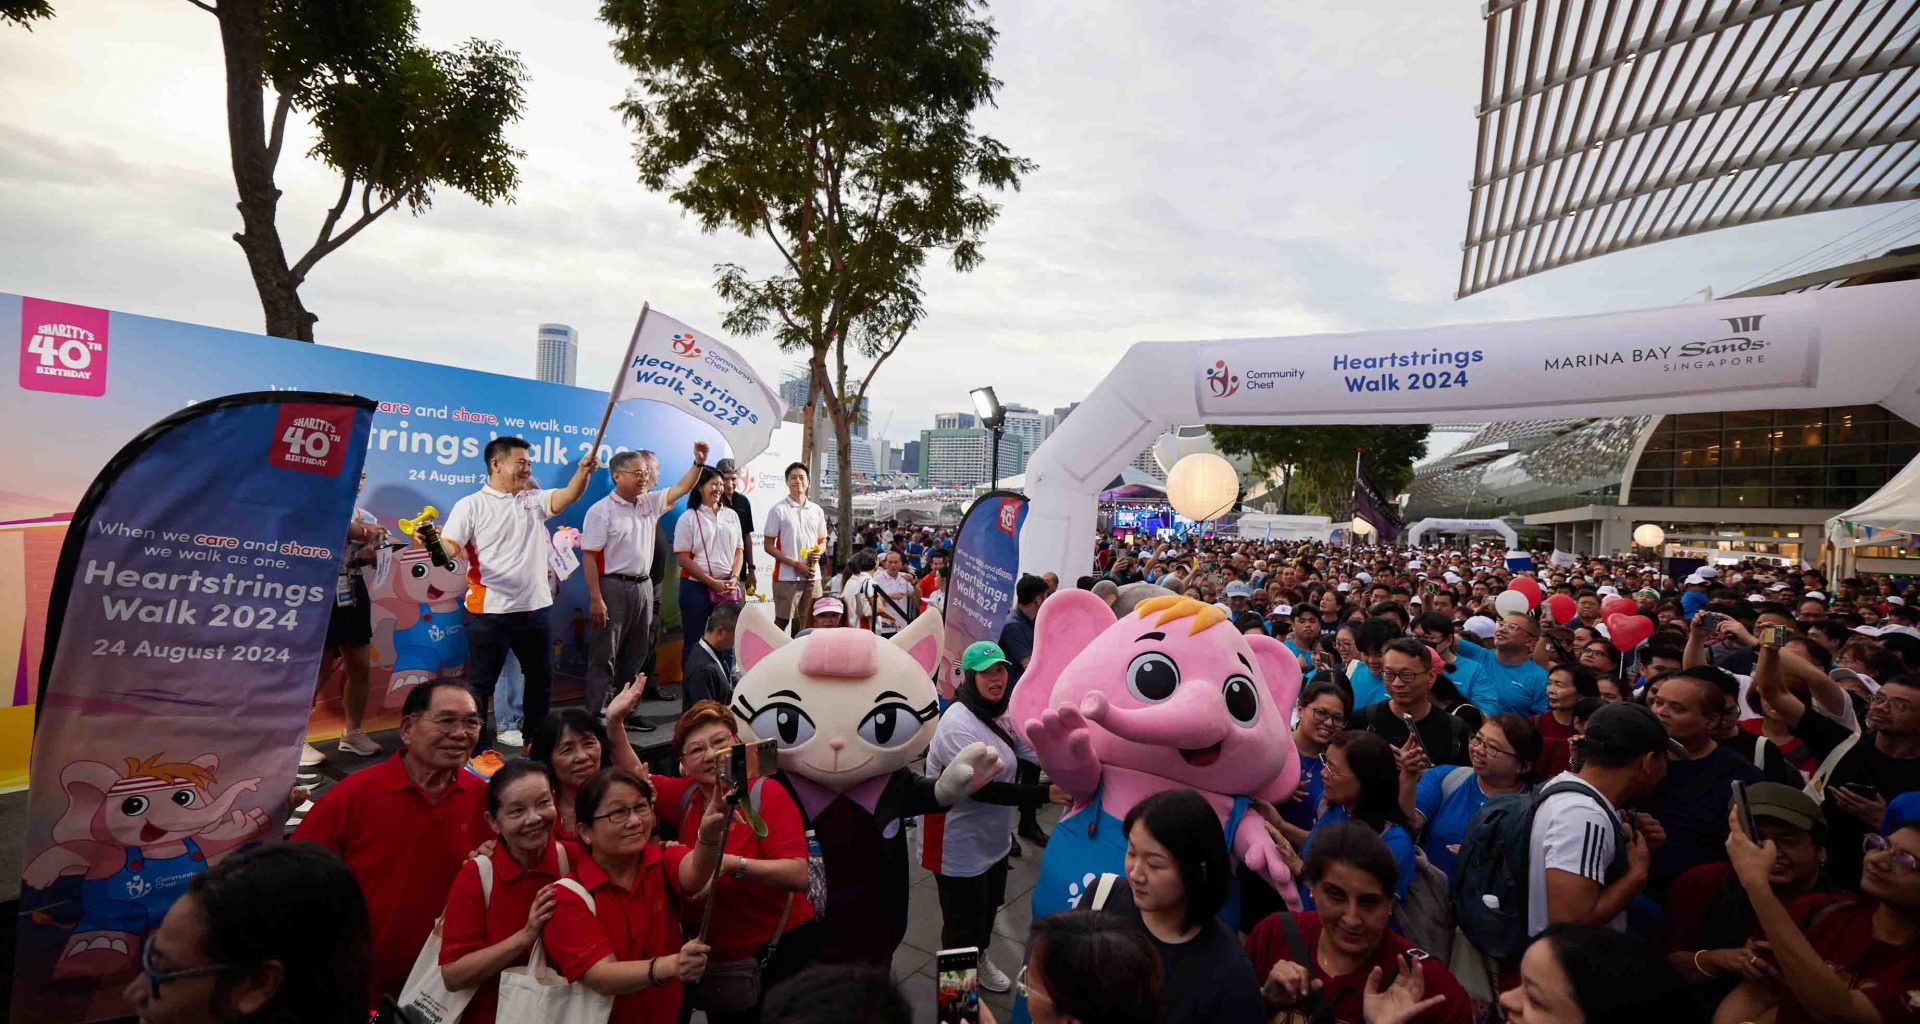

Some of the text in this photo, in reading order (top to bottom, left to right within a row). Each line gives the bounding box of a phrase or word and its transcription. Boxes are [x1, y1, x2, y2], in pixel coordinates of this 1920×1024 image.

[704, 356, 730, 374] Chest
[1333, 348, 1484, 371] Heartstrings
[1544, 337, 1767, 371] MARINA BAY Sands
[1663, 355, 1767, 372] SINGAPORE
[35, 366, 92, 379] BIRTHDAY
[708, 350, 755, 384] Community
[1246, 368, 1305, 380] Community
[632, 353, 759, 424] Heartstrings
[1246, 380, 1275, 390] Chest
[1344, 370, 1468, 392] Walk 2024
[636, 370, 740, 426] Walk 2024
[415, 405, 448, 421] and
[452, 407, 500, 427] share,
[504, 416, 525, 429] we
[528, 418, 560, 433] walk
[562, 423, 578, 435] as
[285, 453, 328, 467] BIRTHDAY
[408, 469, 427, 481] 24
[429, 470, 476, 486] August
[98, 520, 334, 560] When we care and share,
[143, 545, 291, 570] we walk as one.
[984, 564, 996, 573] and
[84, 559, 325, 607] Heartstrings
[953, 563, 1009, 602] Heartstrings
[952, 597, 962, 607] 24
[956, 580, 998, 614] Walk 2024
[101, 595, 299, 631] Walk 2024
[92, 638, 291, 664] 24 August 2024
